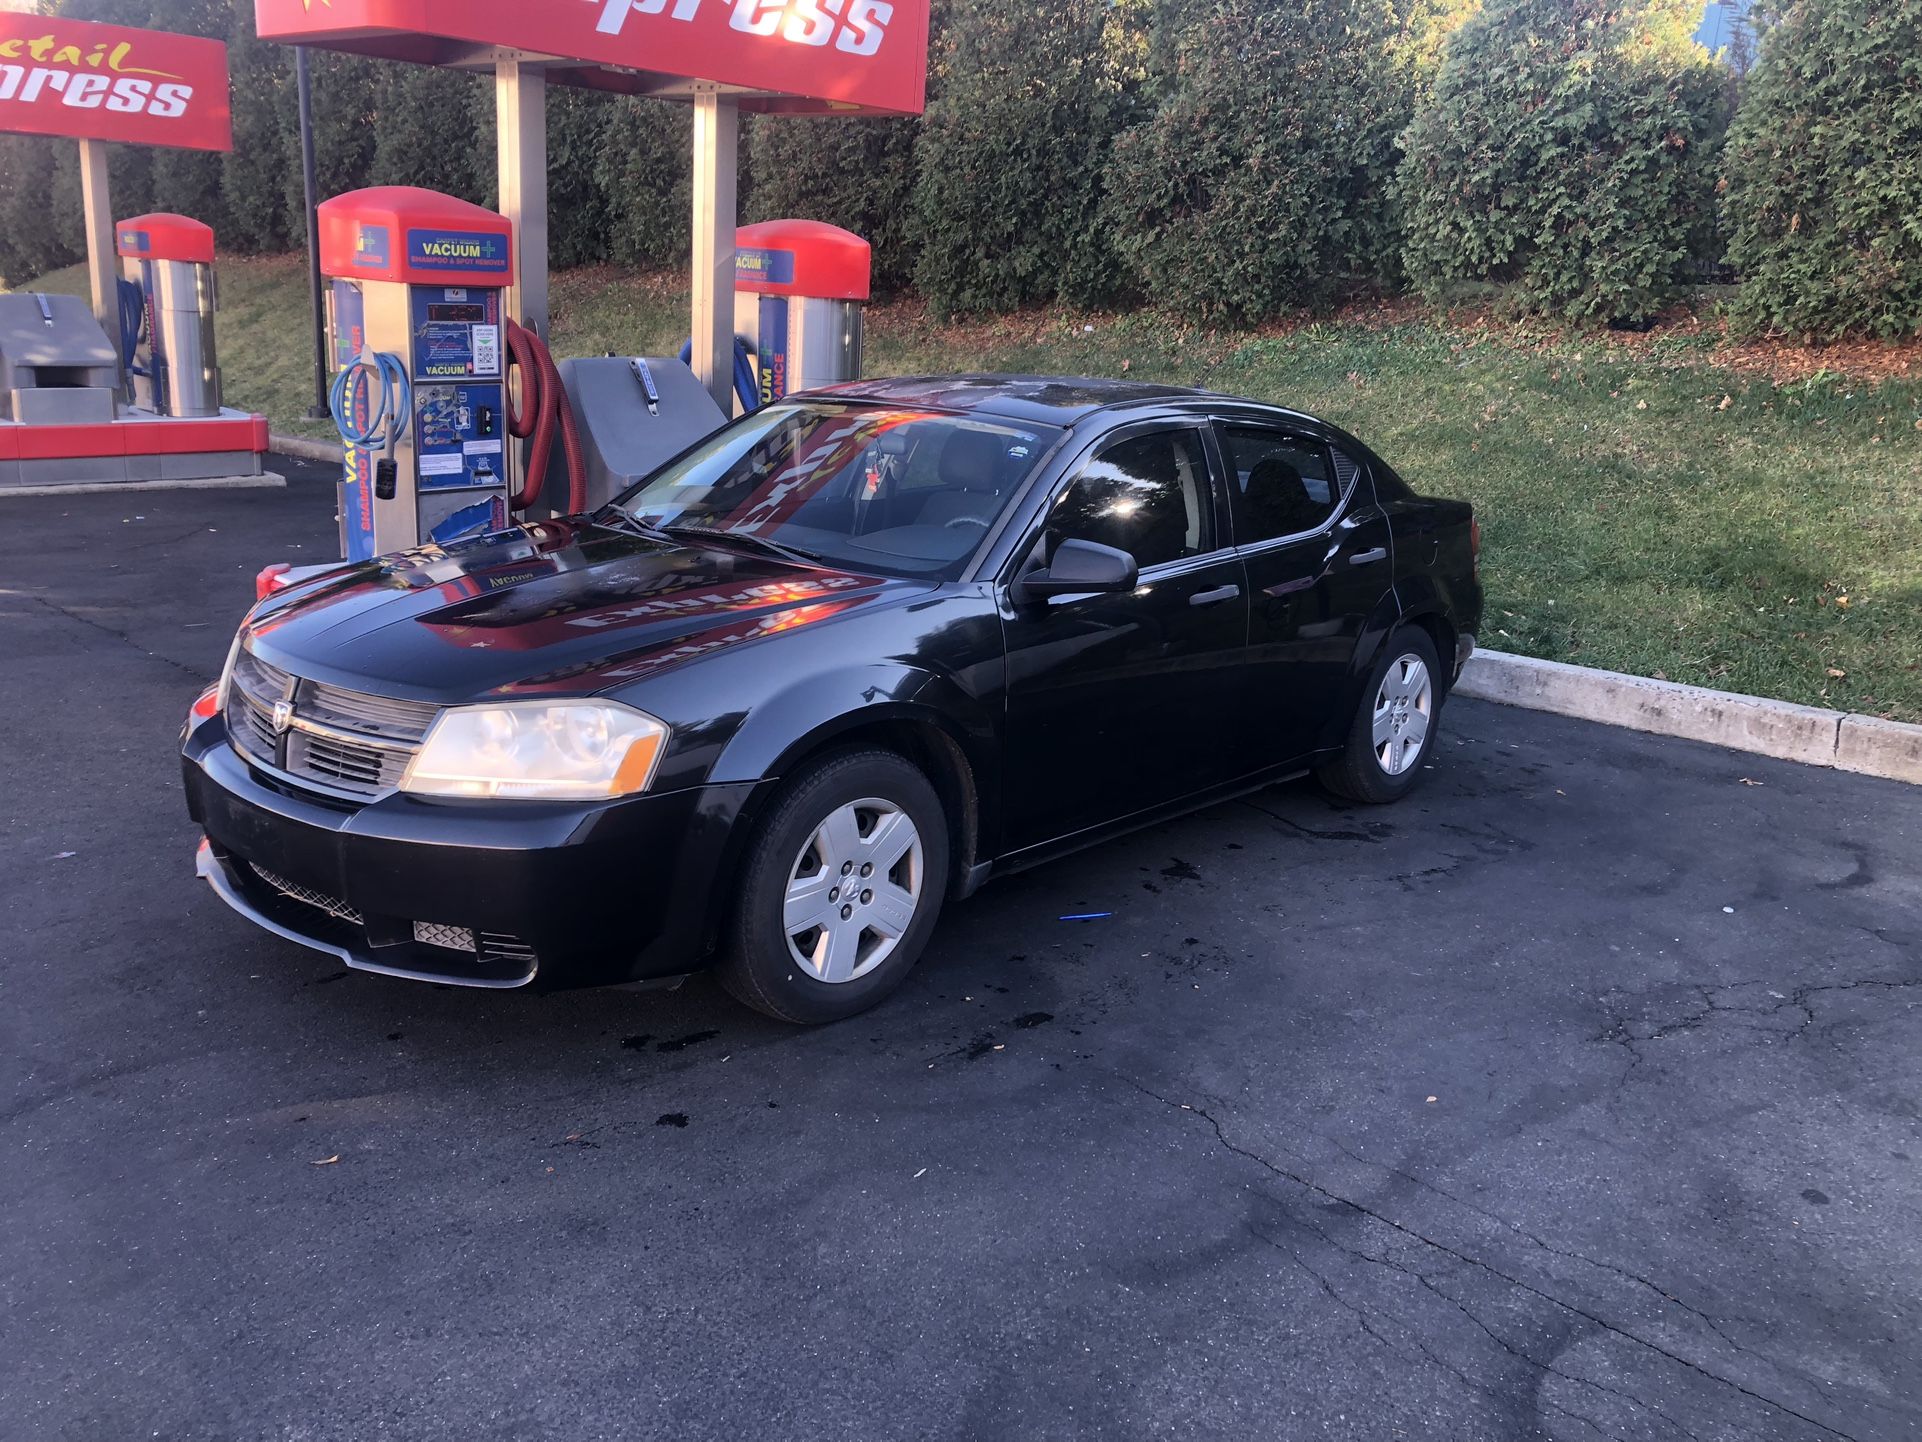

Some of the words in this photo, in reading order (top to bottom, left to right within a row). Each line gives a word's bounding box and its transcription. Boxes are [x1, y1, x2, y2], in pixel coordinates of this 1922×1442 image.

[422, 243, 480, 257] VACUUM
[411, 255, 448, 264] SHAMPOO
[456, 257, 474, 265] SPOT
[475, 258, 505, 266] REMOVER
[735, 256, 762, 270] ACUUM
[425, 364, 465, 375] VACUUM
[774, 353, 785, 401] ANCE
[359, 458, 371, 531] SHAMPOO
